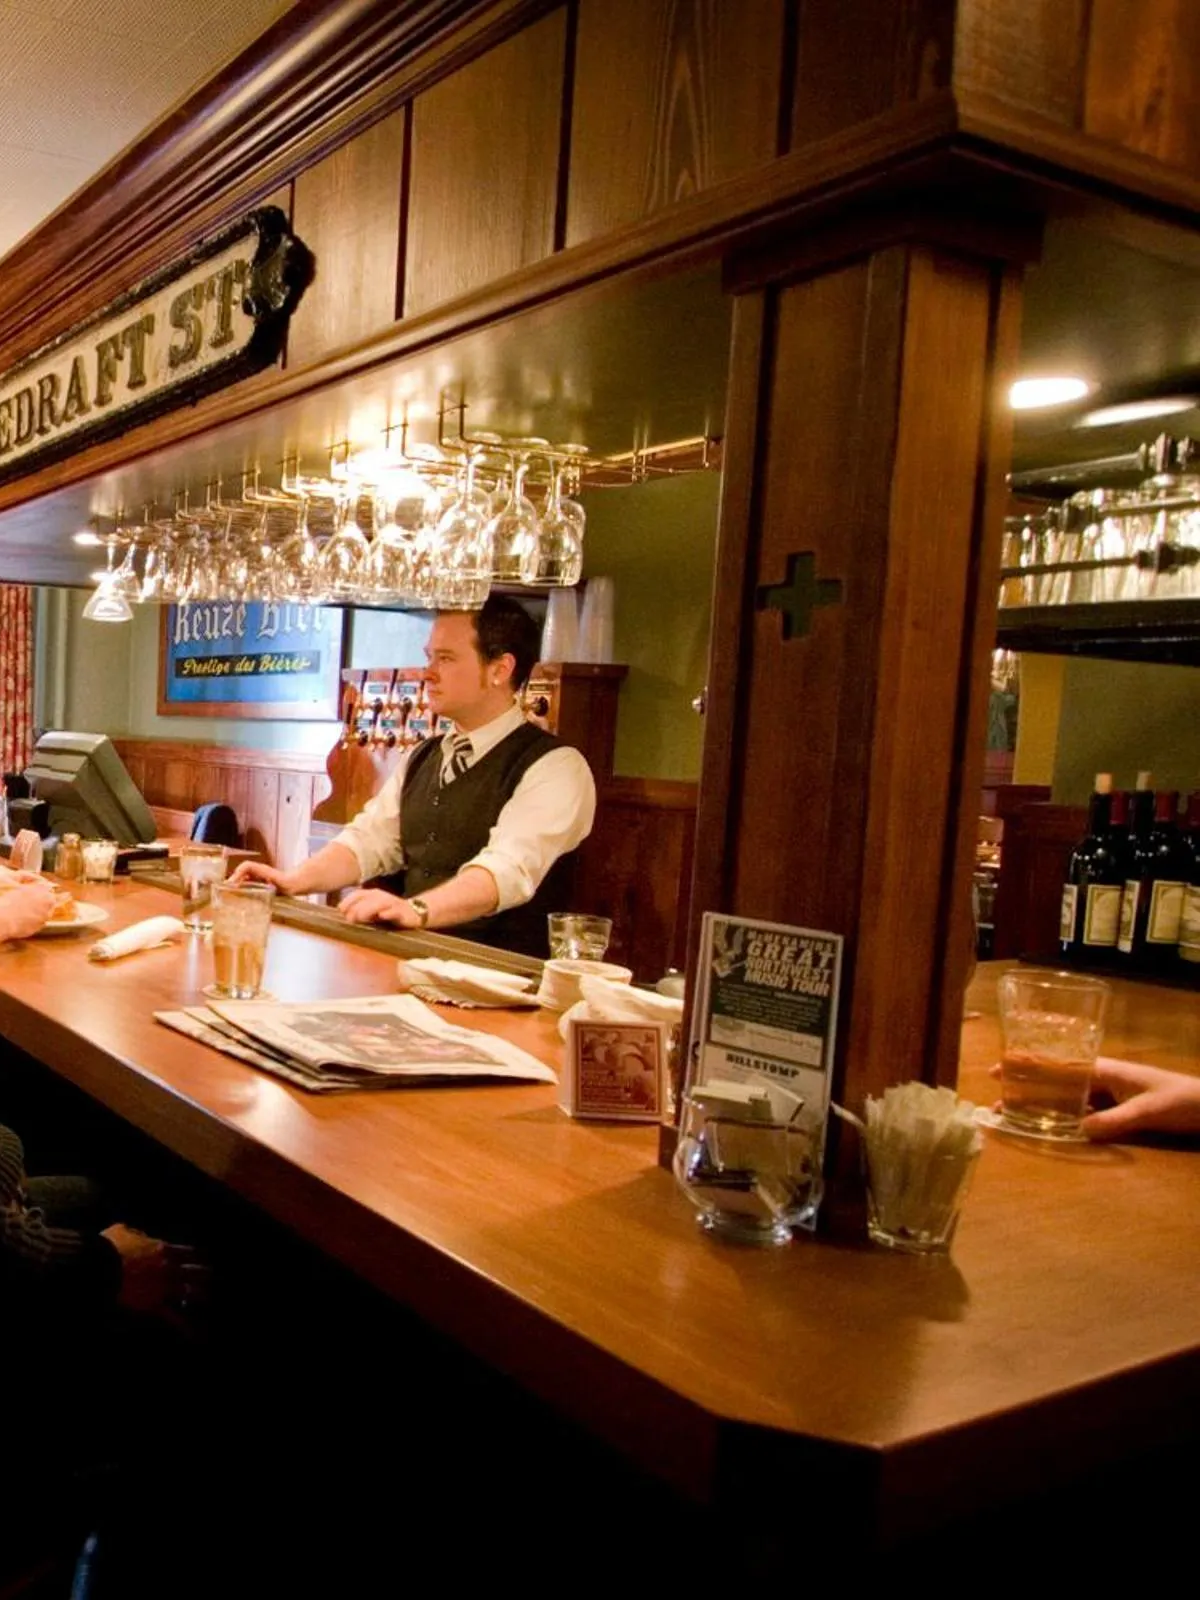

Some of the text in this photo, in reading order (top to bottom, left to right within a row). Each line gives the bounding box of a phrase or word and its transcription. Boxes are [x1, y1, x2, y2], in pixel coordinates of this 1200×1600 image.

[168, 258, 247, 369] ST
[182, 657, 230, 676] Prestige
[235, 656, 256, 673] des
[747, 940, 834, 968] GREAT
[744, 969, 830, 997] MUSIC TOUR
[745, 957, 831, 981] NORTHWEST
